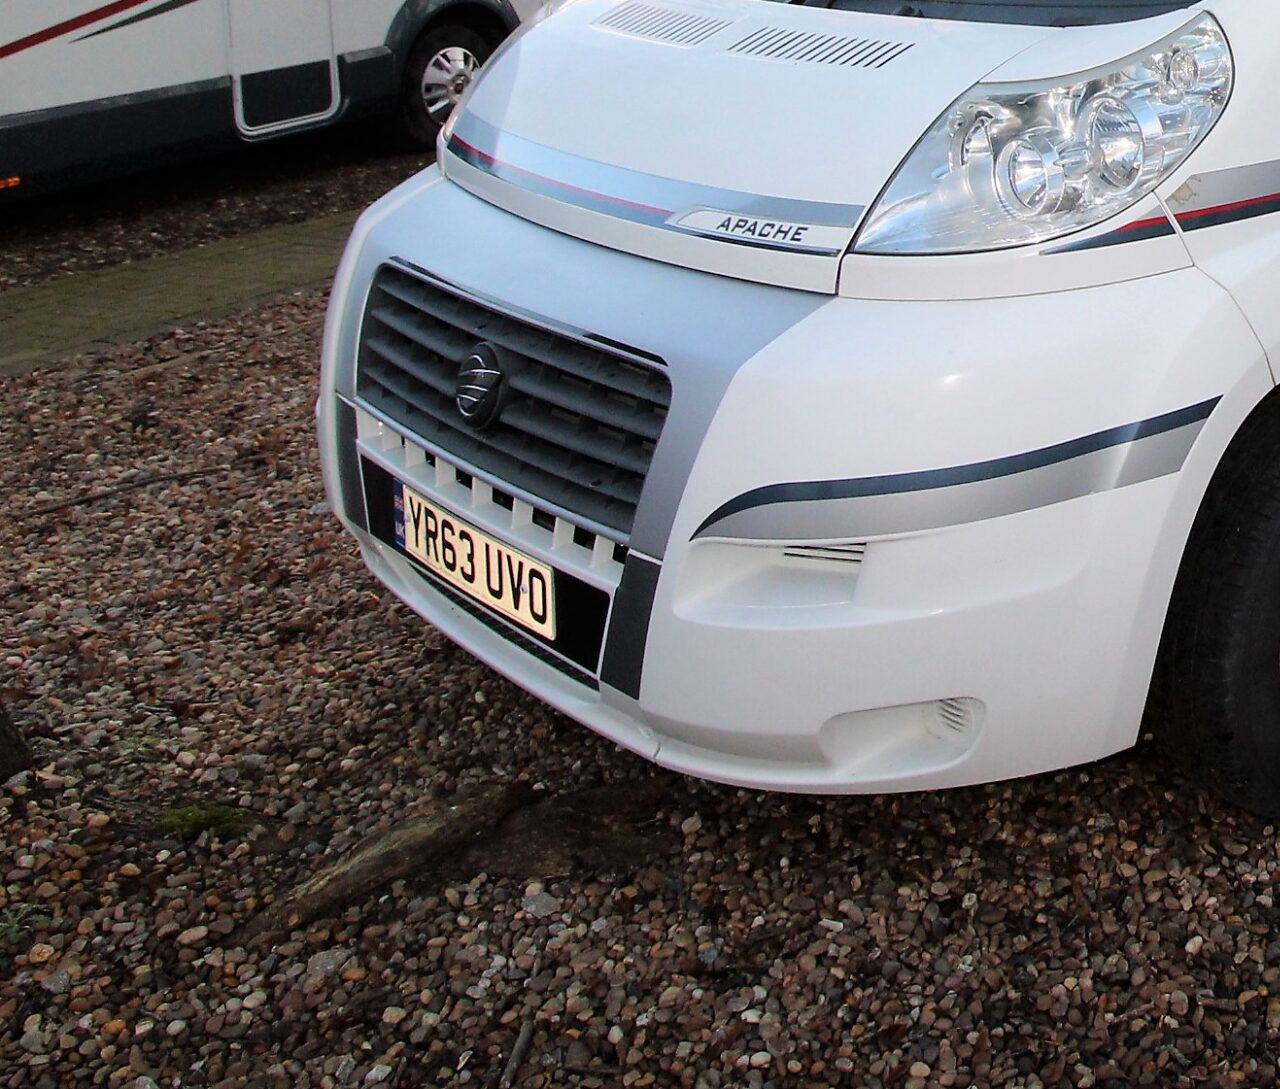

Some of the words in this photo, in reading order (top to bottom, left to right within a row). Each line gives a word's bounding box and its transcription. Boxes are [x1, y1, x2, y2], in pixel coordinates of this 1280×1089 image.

[716, 216, 809, 242] APACHE
[409, 496, 476, 584] YR63
[485, 543, 547, 625] UVO
